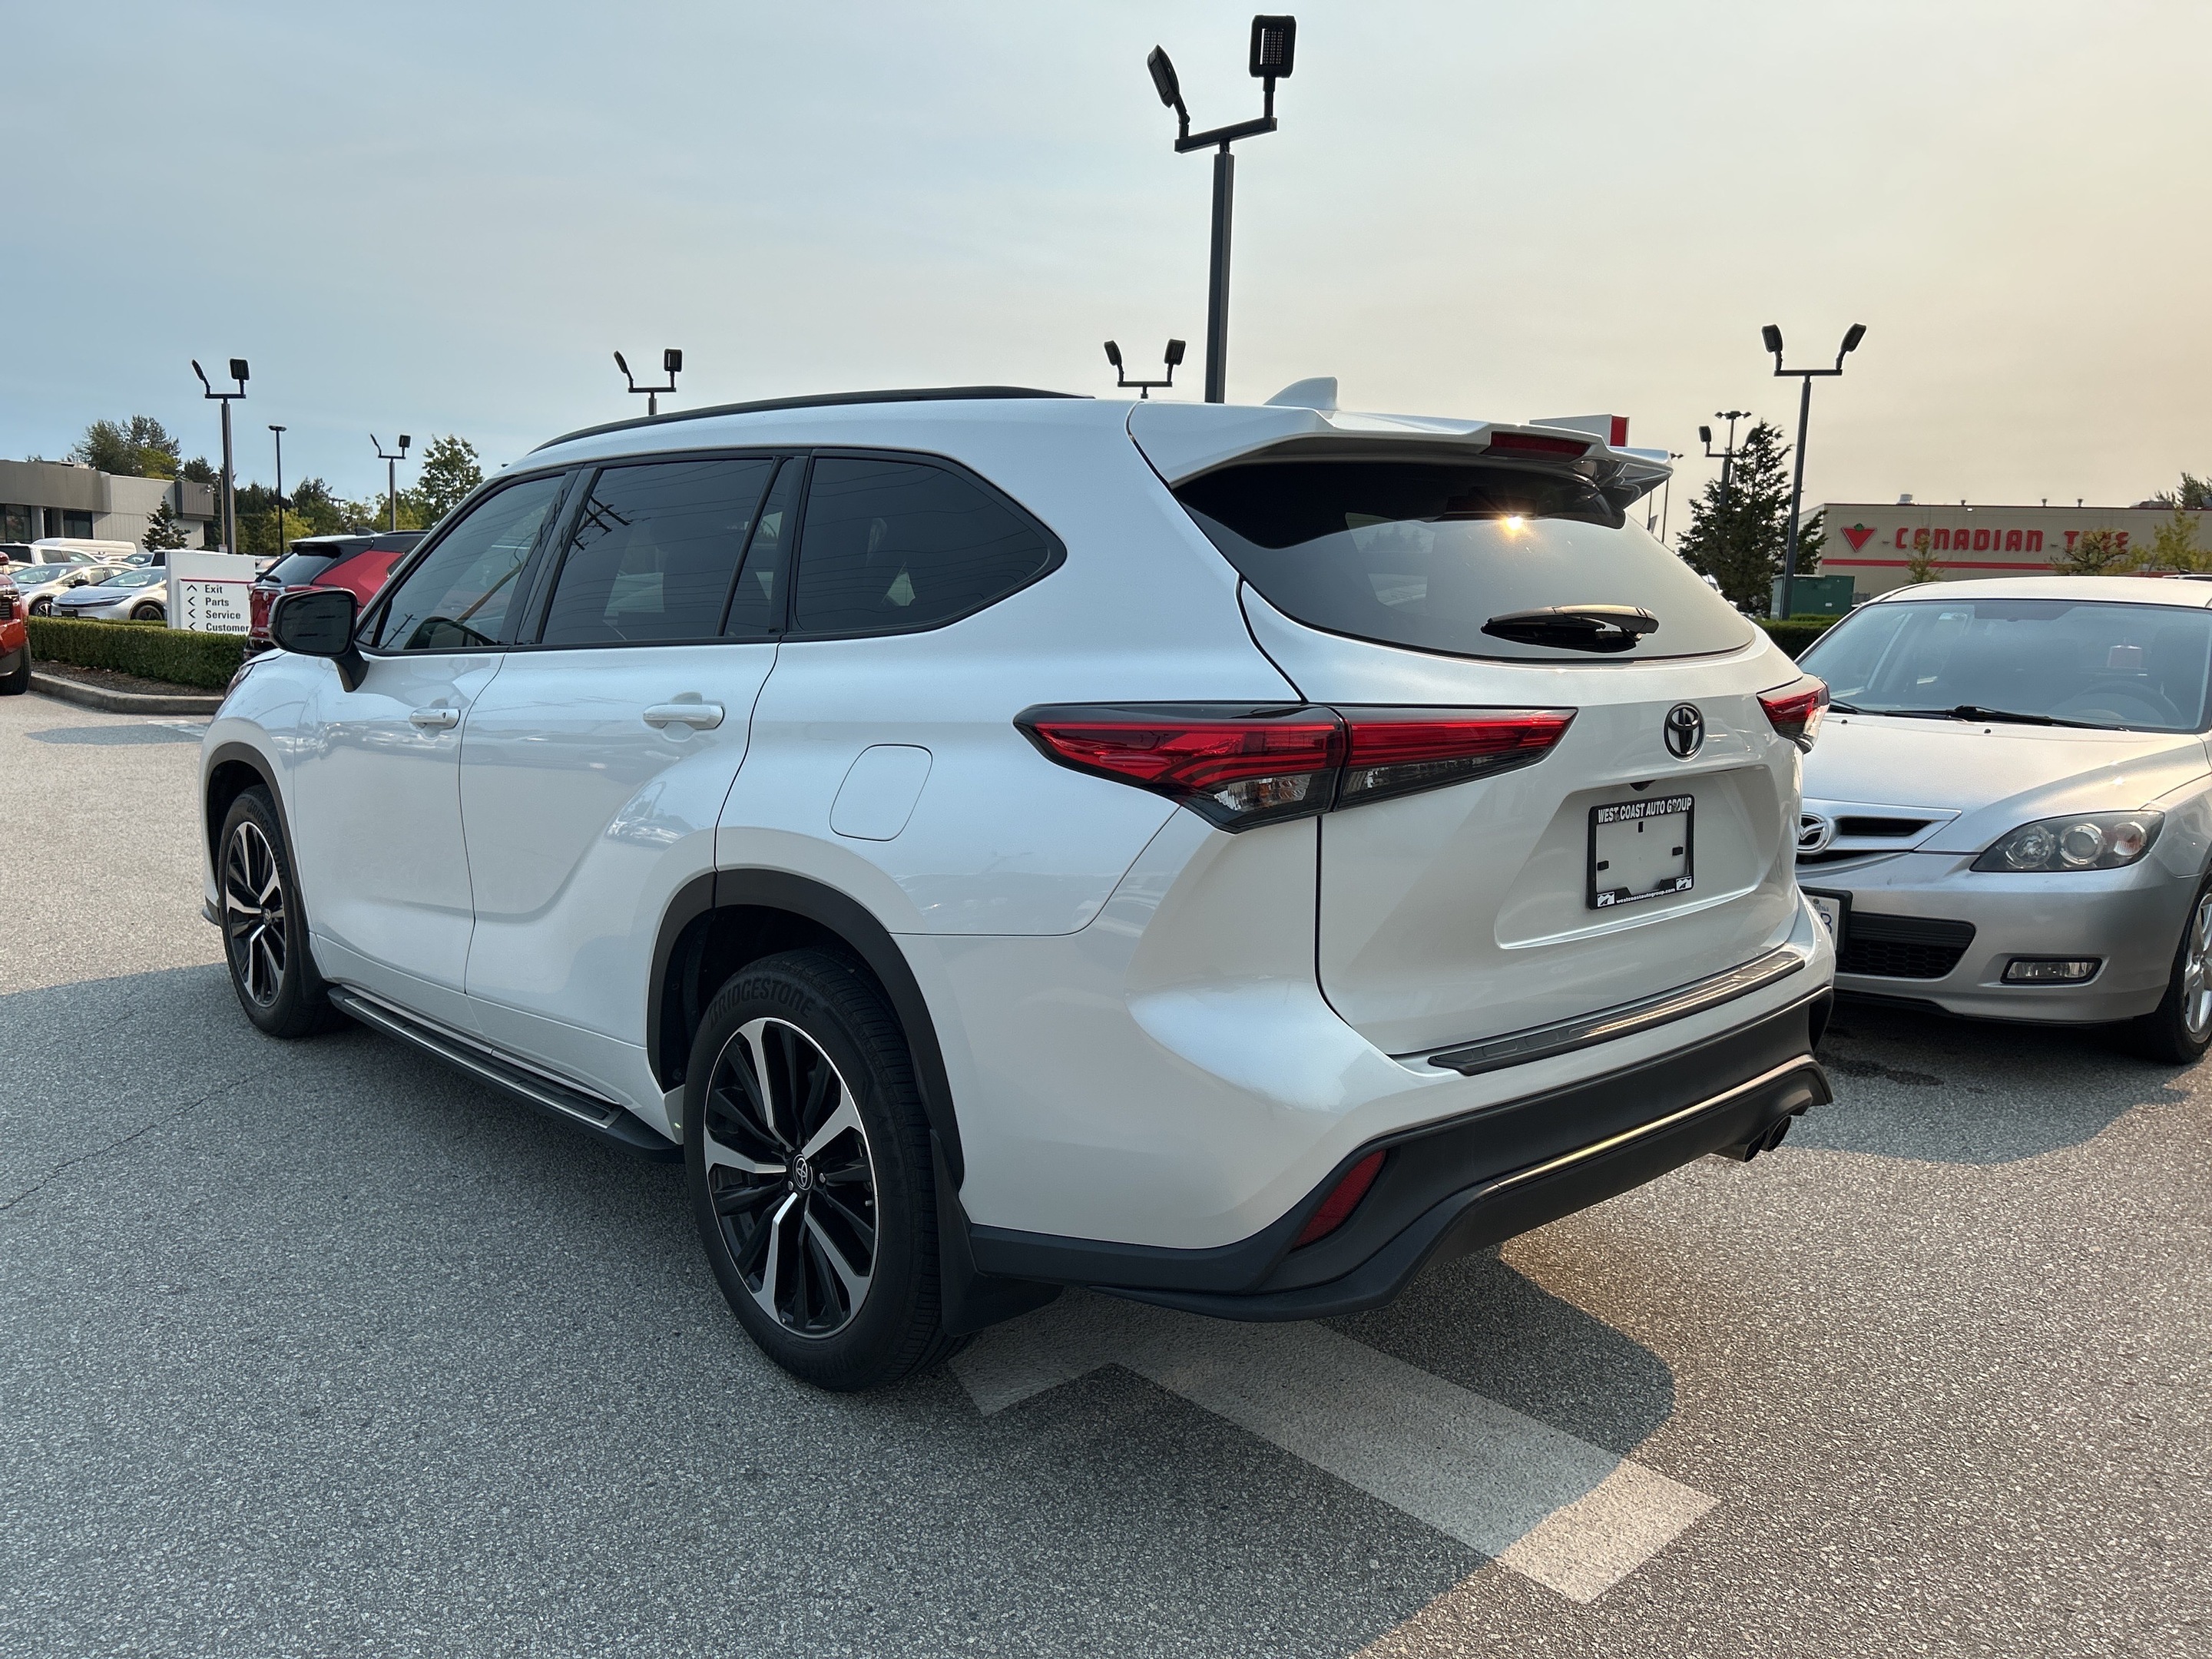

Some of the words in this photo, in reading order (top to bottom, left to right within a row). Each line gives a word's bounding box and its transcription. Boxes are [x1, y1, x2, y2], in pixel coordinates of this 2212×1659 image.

[1896, 528, 2043, 551] CANADIAN
[204, 584, 223, 594] Exit
[205, 597, 229, 607] Parts
[206, 610, 240, 619] Service
[206, 623, 249, 632] Customer
[1620, 803, 1645, 820] COAST
[1645, 800, 1665, 816] AUTO
[1616, 888, 1676, 904] westcoastautogroup.com
[708, 975, 817, 1031] BRIDGESTONE
